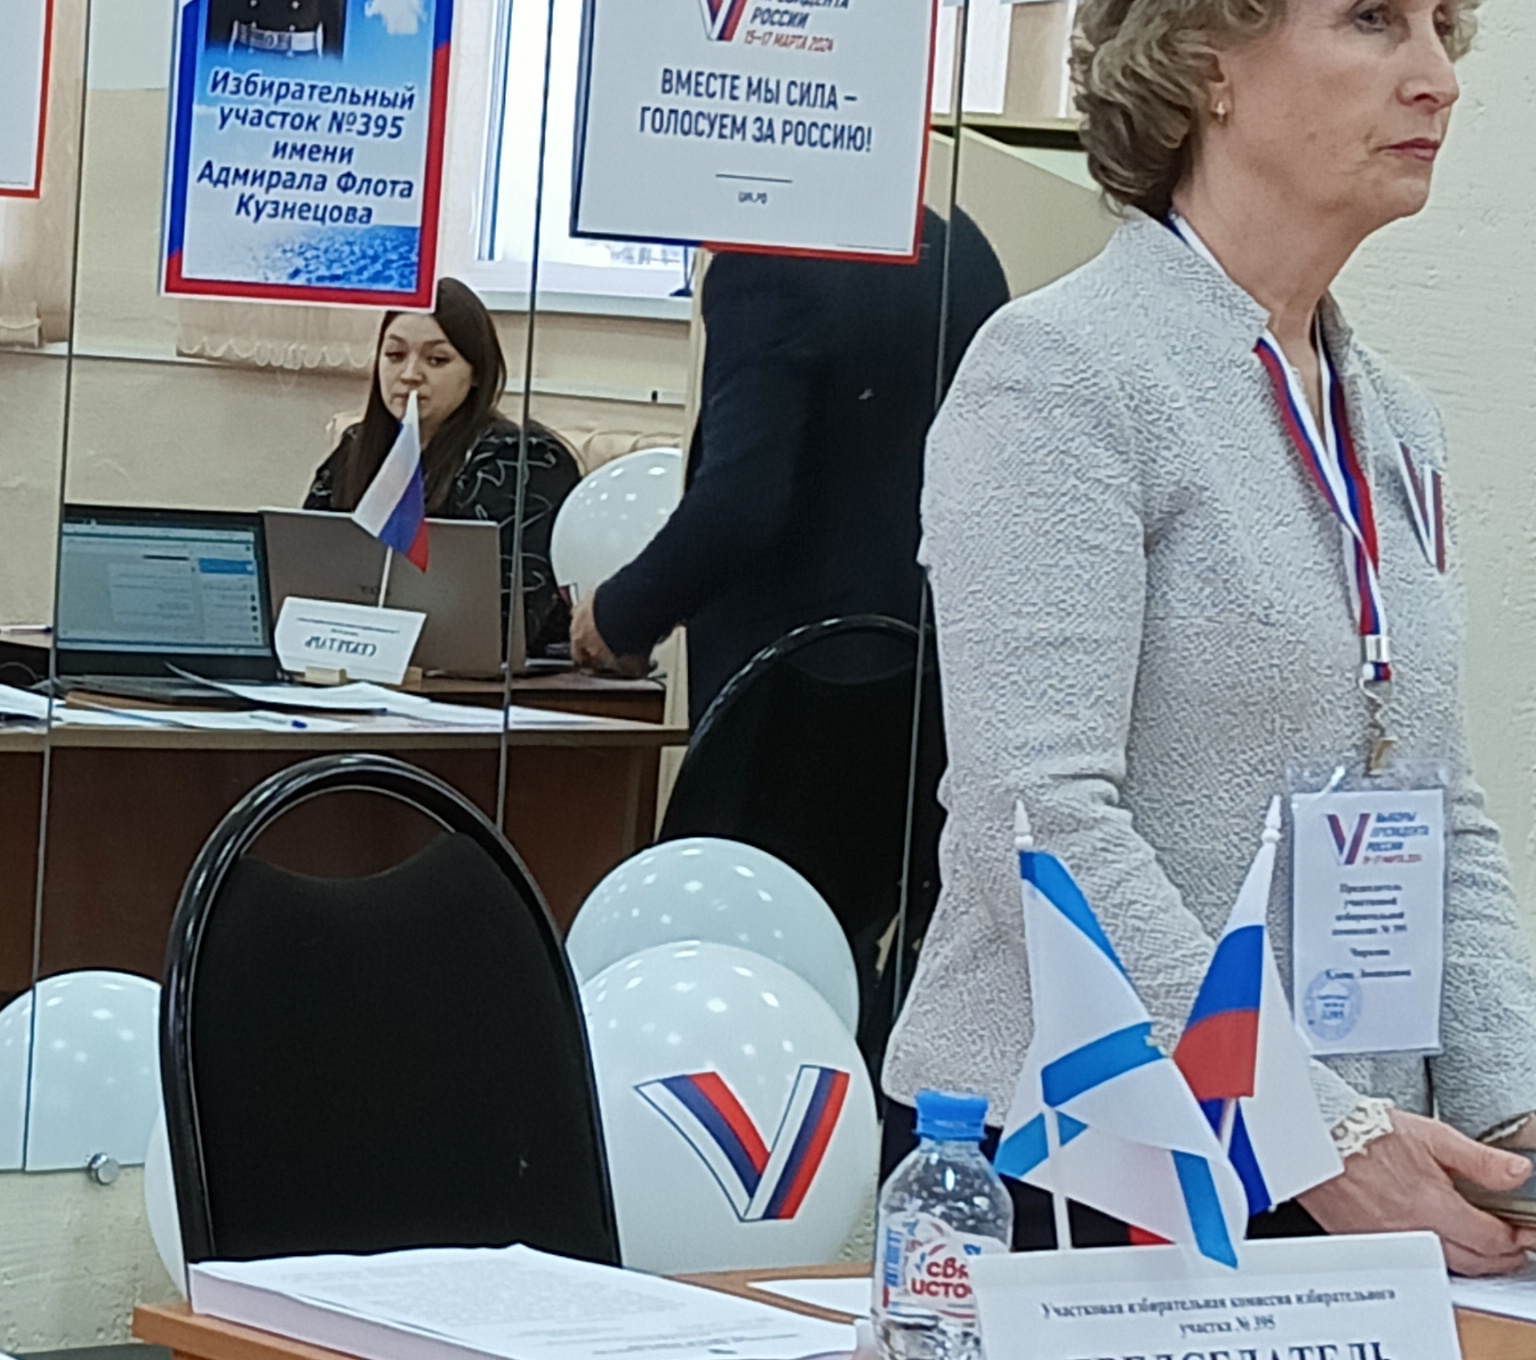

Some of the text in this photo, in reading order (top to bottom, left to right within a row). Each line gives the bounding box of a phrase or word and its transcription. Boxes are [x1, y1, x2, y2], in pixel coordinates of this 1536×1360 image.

[750, 7, 810, 28] РОССИИ
[773, 33, 807, 50] МАРТА
[210, 70, 415, 110] Избирательный
[661, 68, 740, 101] ВМЕСТЕ
[746, 76, 779, 105] МЫ
[786, 80, 838, 110] СИЛА
[218, 105, 404, 138] участок №395
[639, 106, 872, 152] ГОЛОСУЕМ ЗА РОССИЮ!
[271, 141, 353, 165] имени
[197, 160, 413, 199] Адмирала Флота
[235, 194, 373, 225] Кузнецова
